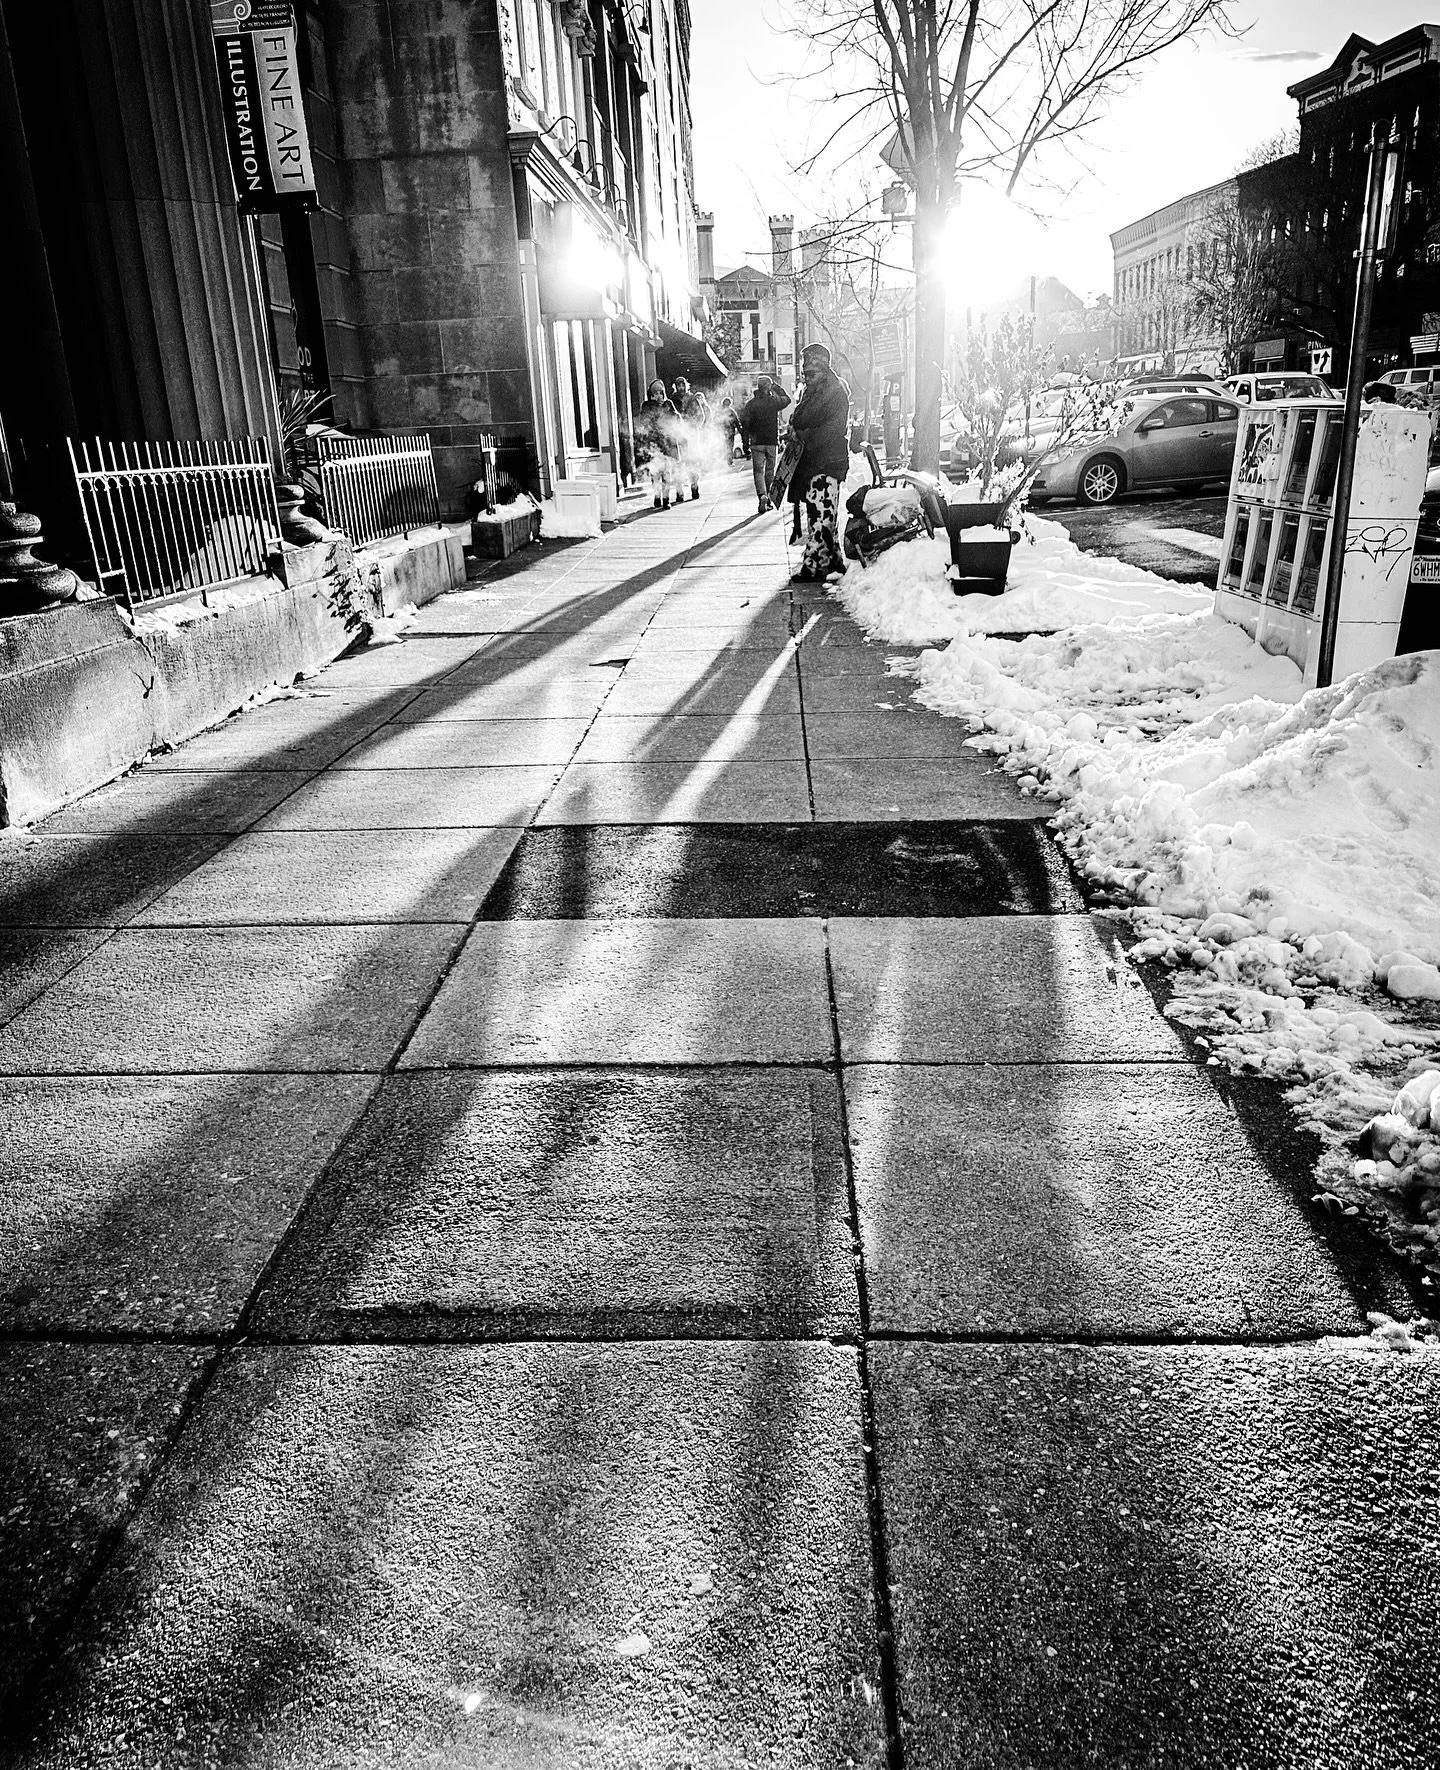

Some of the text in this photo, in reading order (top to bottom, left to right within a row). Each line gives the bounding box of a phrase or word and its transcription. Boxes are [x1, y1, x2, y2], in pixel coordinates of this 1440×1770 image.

[263, 36, 294, 112] FINE
[226, 40, 263, 191] ILLUSTRATION
[274, 121, 306, 185] ART
